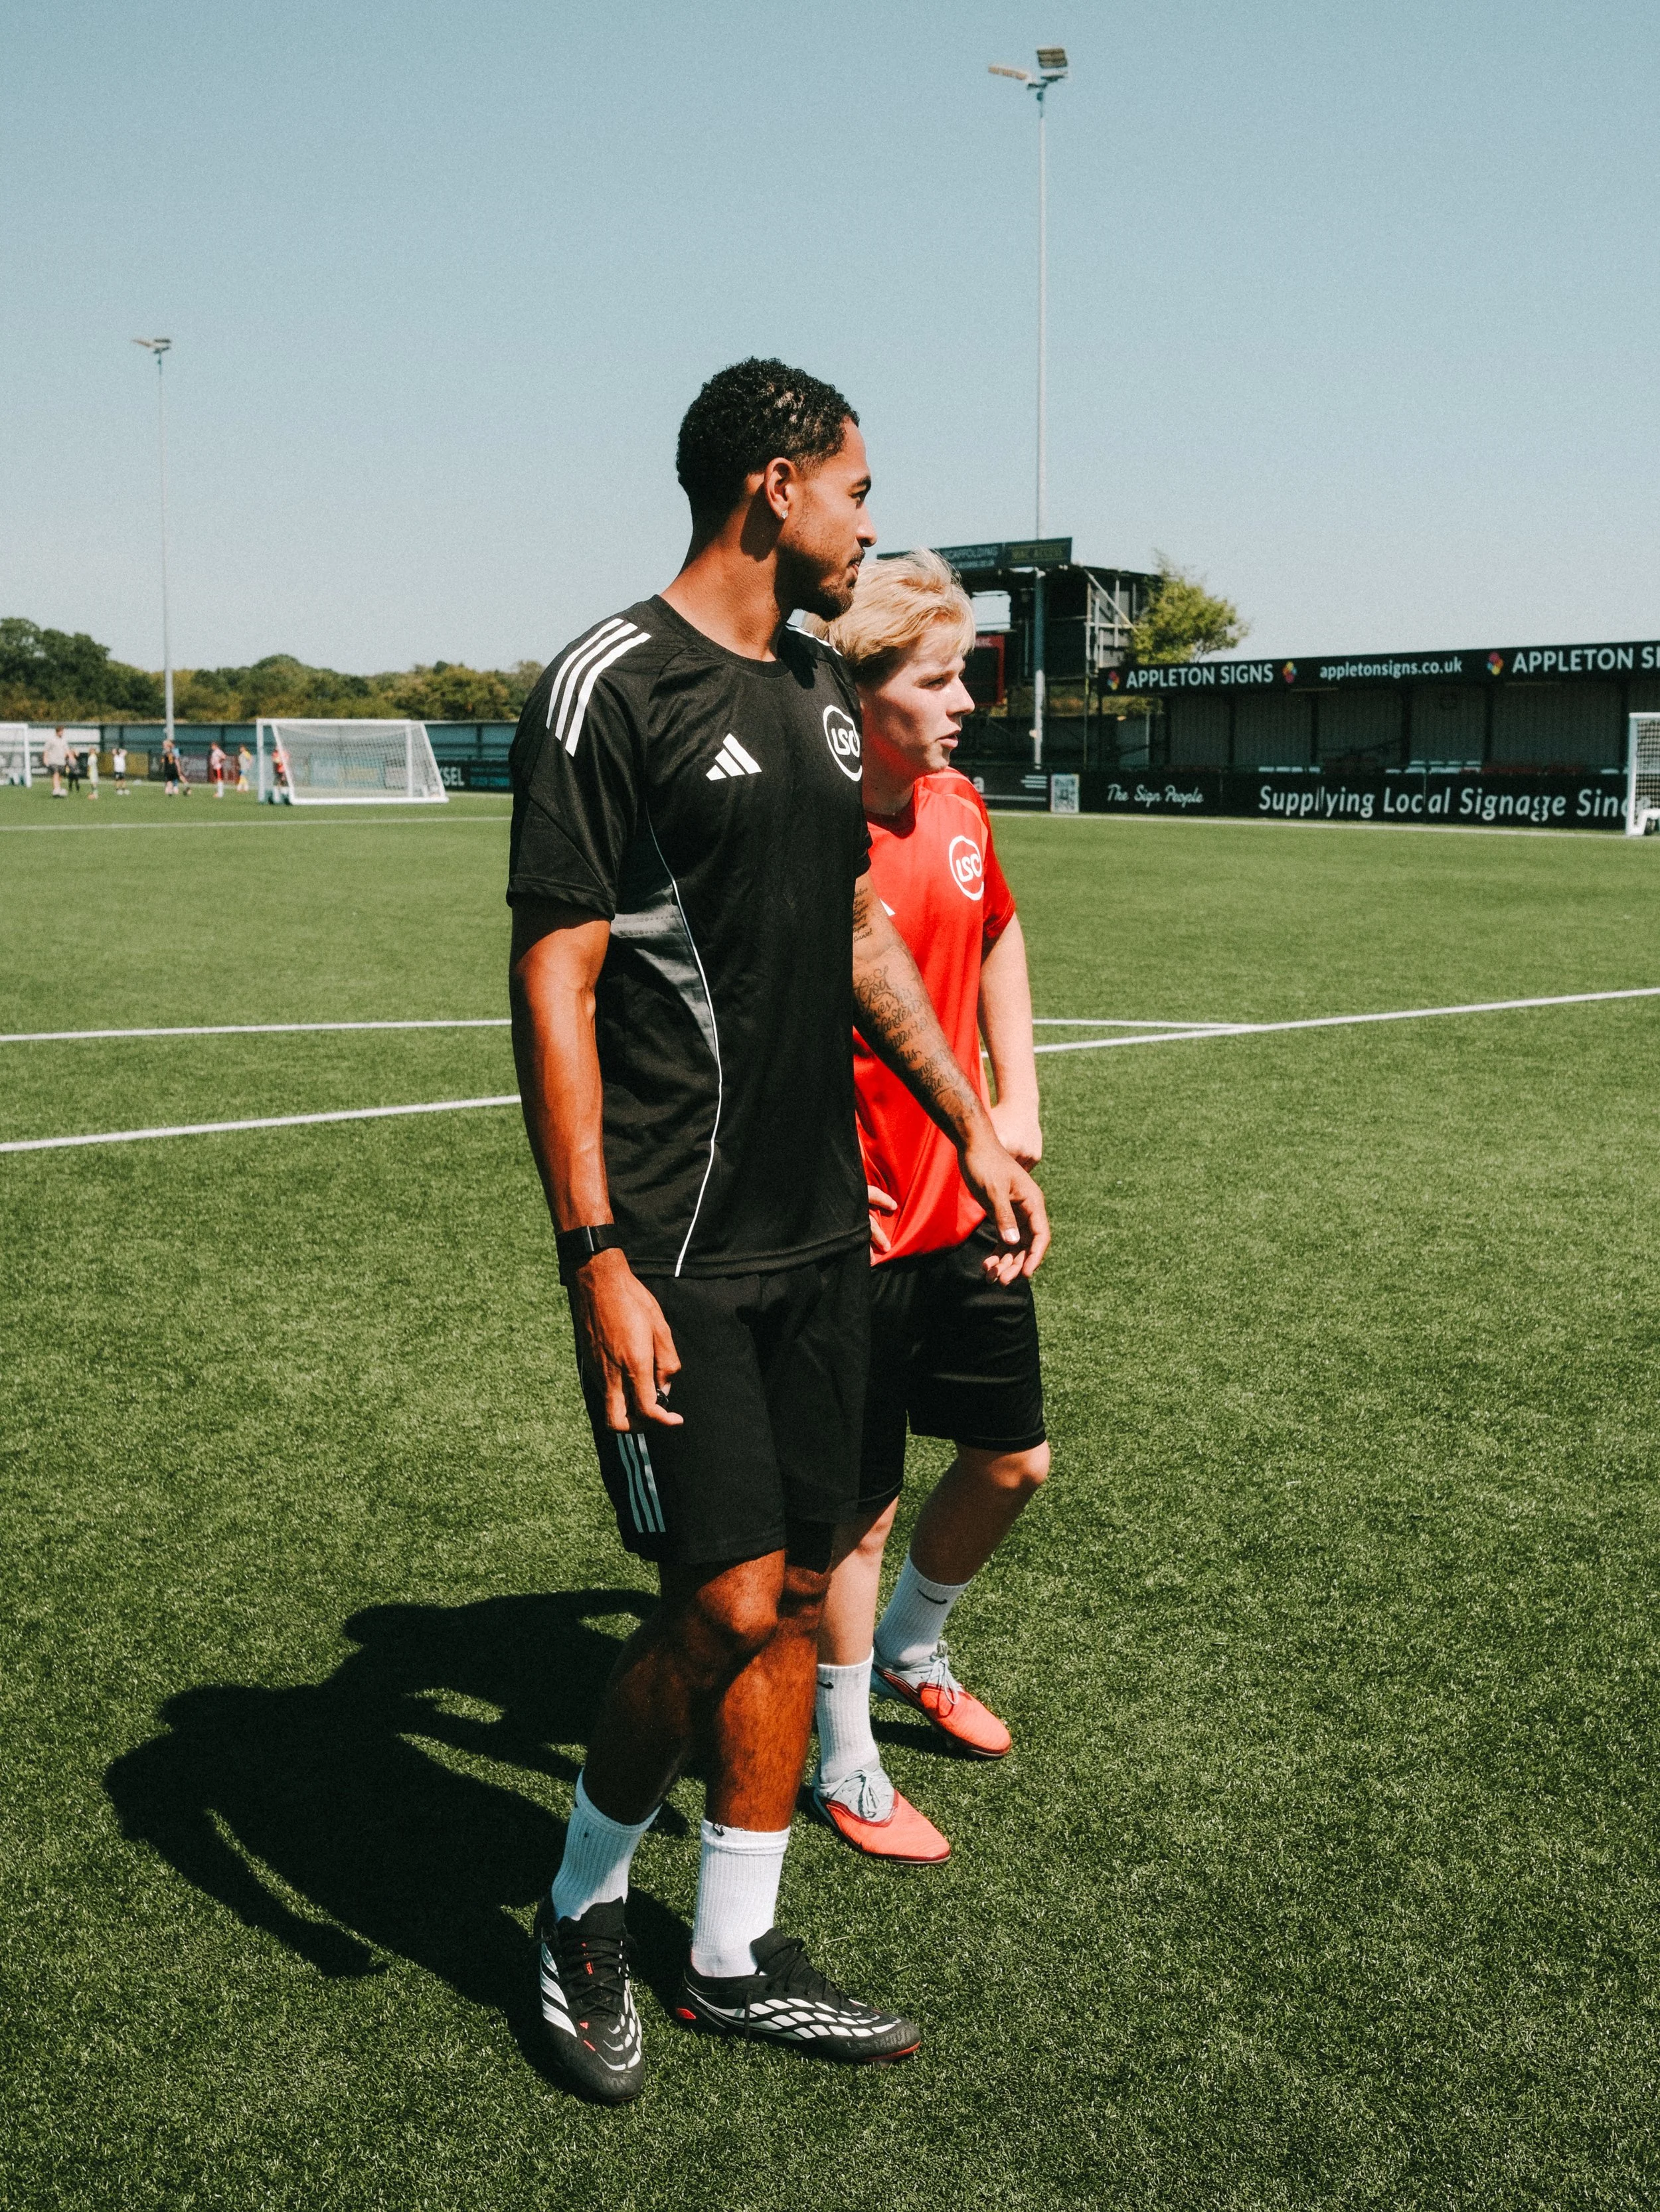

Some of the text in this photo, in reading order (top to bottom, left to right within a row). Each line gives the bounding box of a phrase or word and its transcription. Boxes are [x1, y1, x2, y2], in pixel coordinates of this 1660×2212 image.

[1320, 656, 1462, 680] appletonsigns.co.uk
[1512, 647, 1633, 673] APPLETON
[1126, 664, 1274, 688] APPLETON SIGNS
[1108, 784, 1204, 808] The Sign People
[1259, 786, 1374, 818] Supplying
[1384, 787, 1451, 813] Local
[1459, 788, 1566, 821] Signage
[956, 853, 982, 883] LSC
